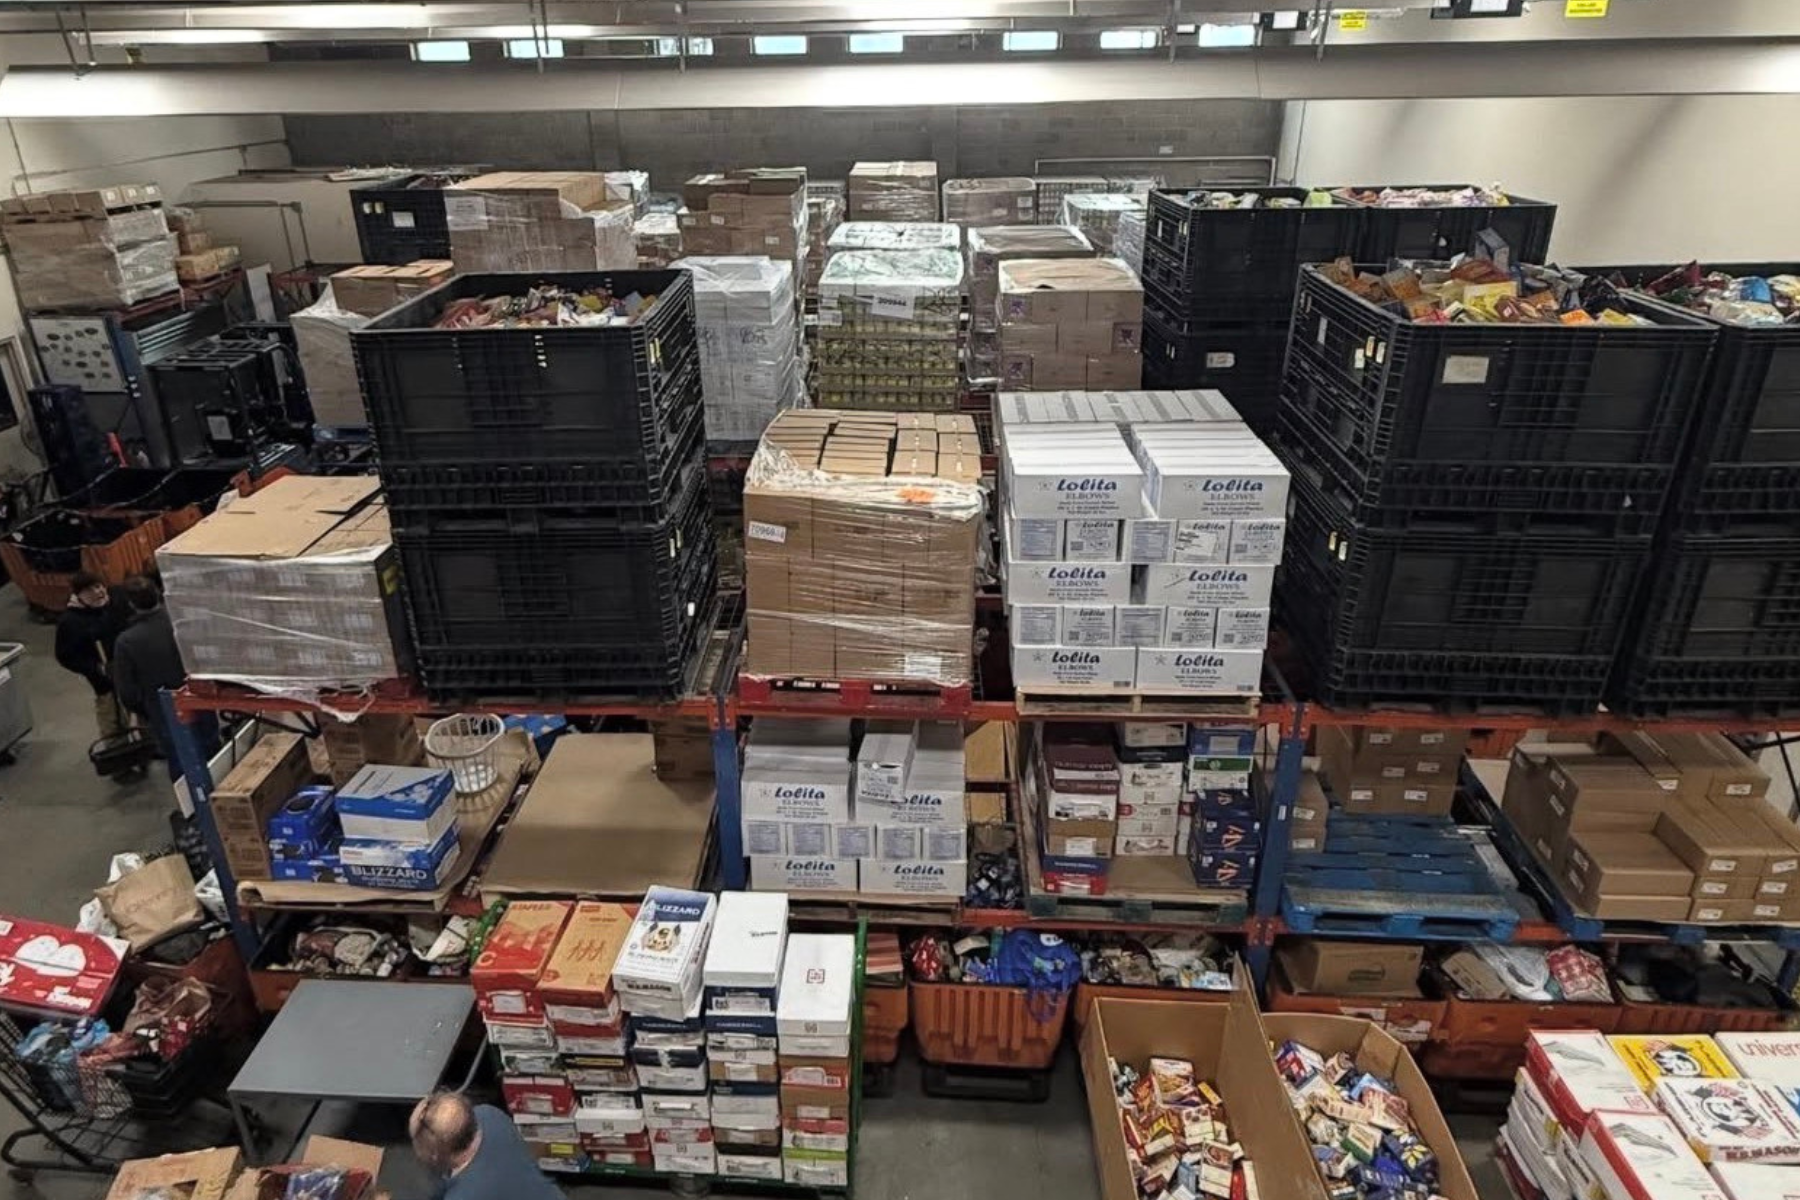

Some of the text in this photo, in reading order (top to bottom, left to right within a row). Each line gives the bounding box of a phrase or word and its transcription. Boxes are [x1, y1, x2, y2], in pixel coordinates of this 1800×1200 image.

[1057, 479, 1117, 491] Lolita
[1202, 479, 1263, 492] Lolita
[1048, 566, 1106, 579] Lolita
[1189, 569, 1248, 581] Lolita
[1052, 651, 1101, 663] Lolita
[1174, 655, 1224, 666] Lolita
[775, 786, 825, 799] Lolita
[785, 860, 835, 871] Lolita
[894, 865, 944, 875] Lolita
[351, 865, 427, 880] BLIZZARD
